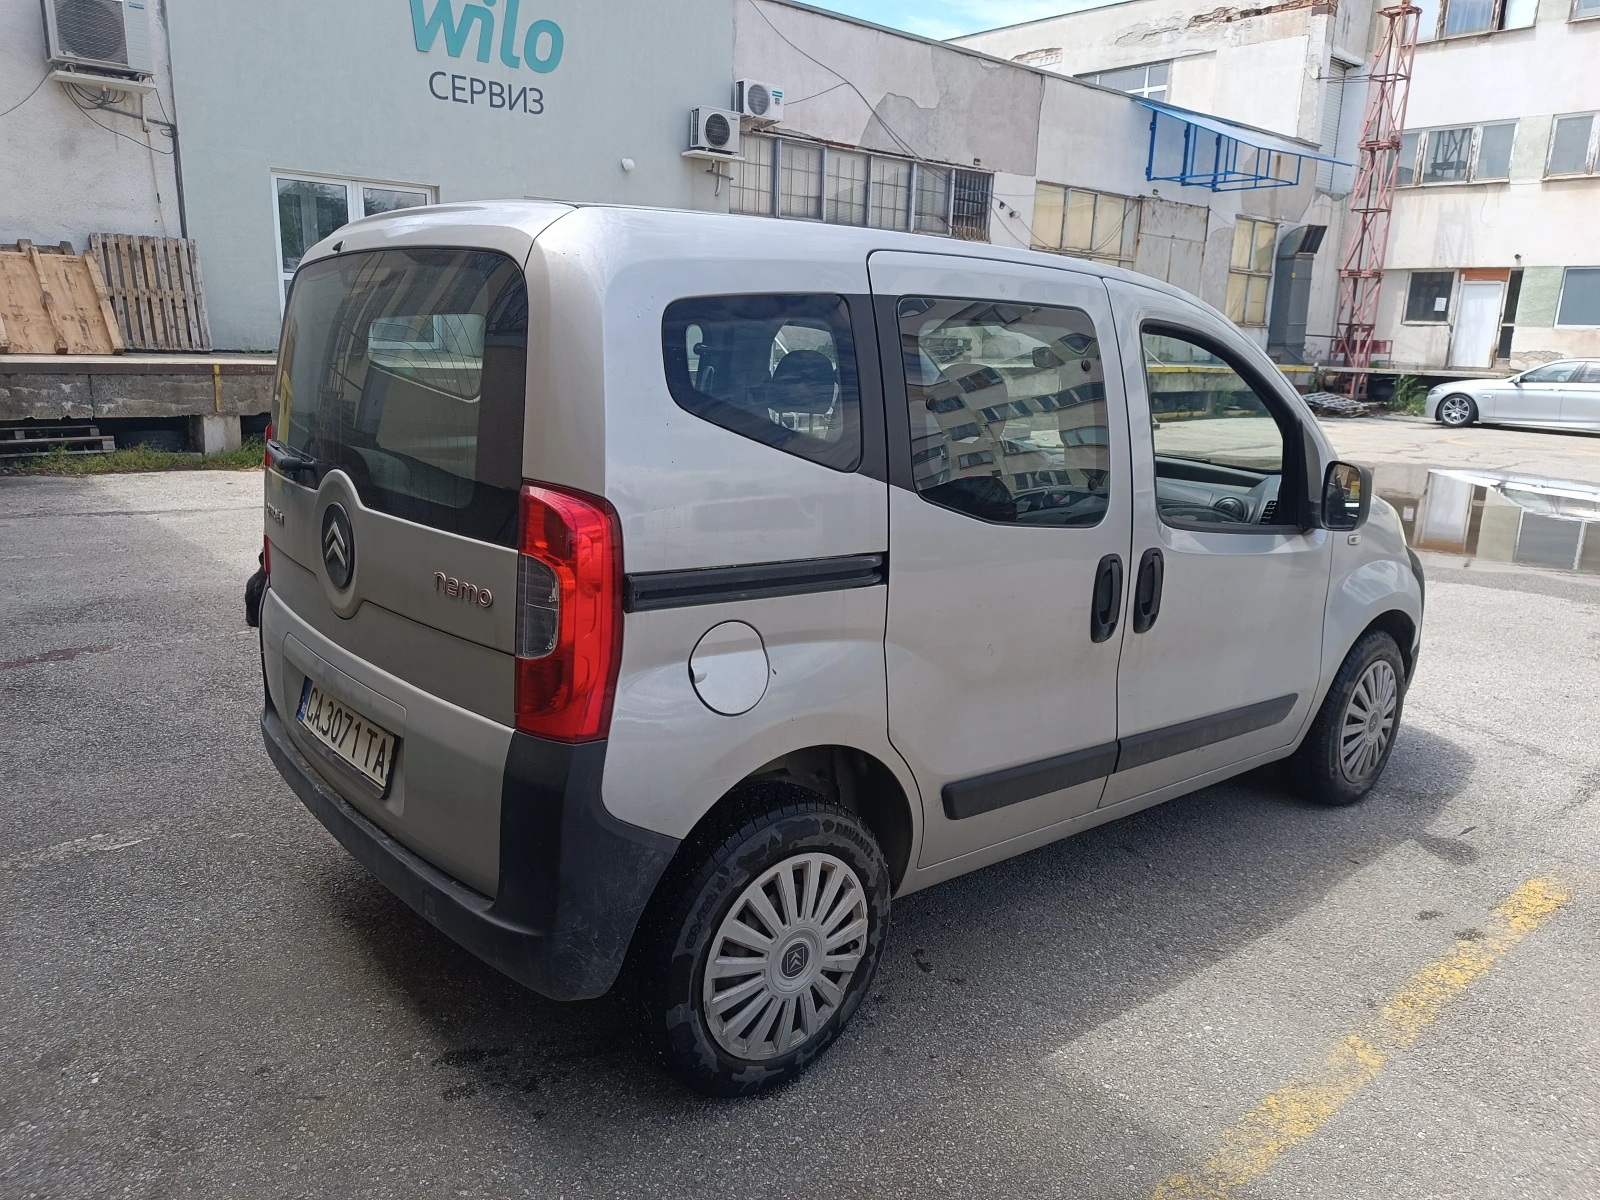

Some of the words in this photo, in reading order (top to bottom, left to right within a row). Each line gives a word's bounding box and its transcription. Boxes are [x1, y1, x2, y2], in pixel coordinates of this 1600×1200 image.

[410, 0, 564, 74] wilo
[428, 71, 544, 115] СЕРВИЗ
[434, 571, 493, 608] nemo
